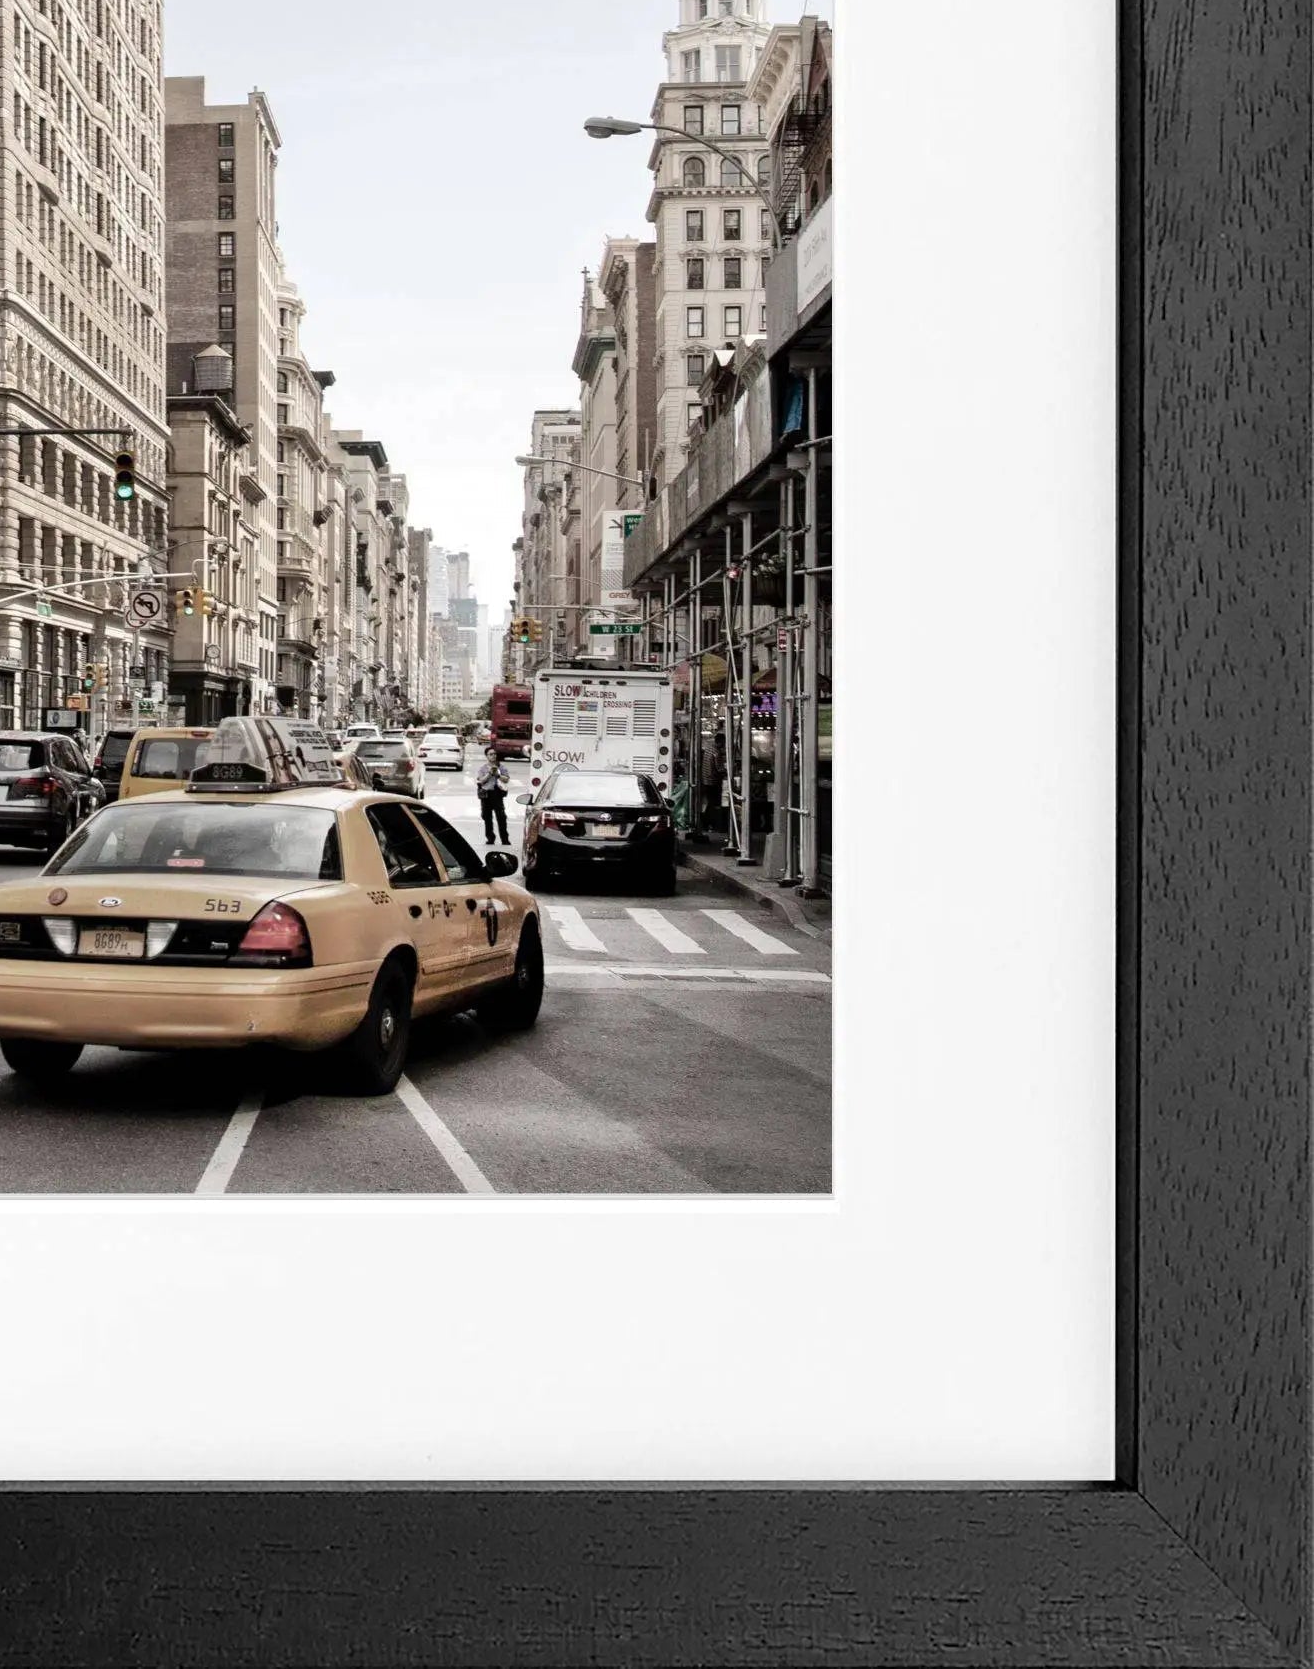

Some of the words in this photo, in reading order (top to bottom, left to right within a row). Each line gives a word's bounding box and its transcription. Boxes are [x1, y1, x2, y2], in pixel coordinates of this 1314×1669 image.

[602, 625, 610, 633] W
[613, 625, 623, 633] 23
[545, 750, 585, 763] SLOW!
[213, 765, 243, 778] 8G89
